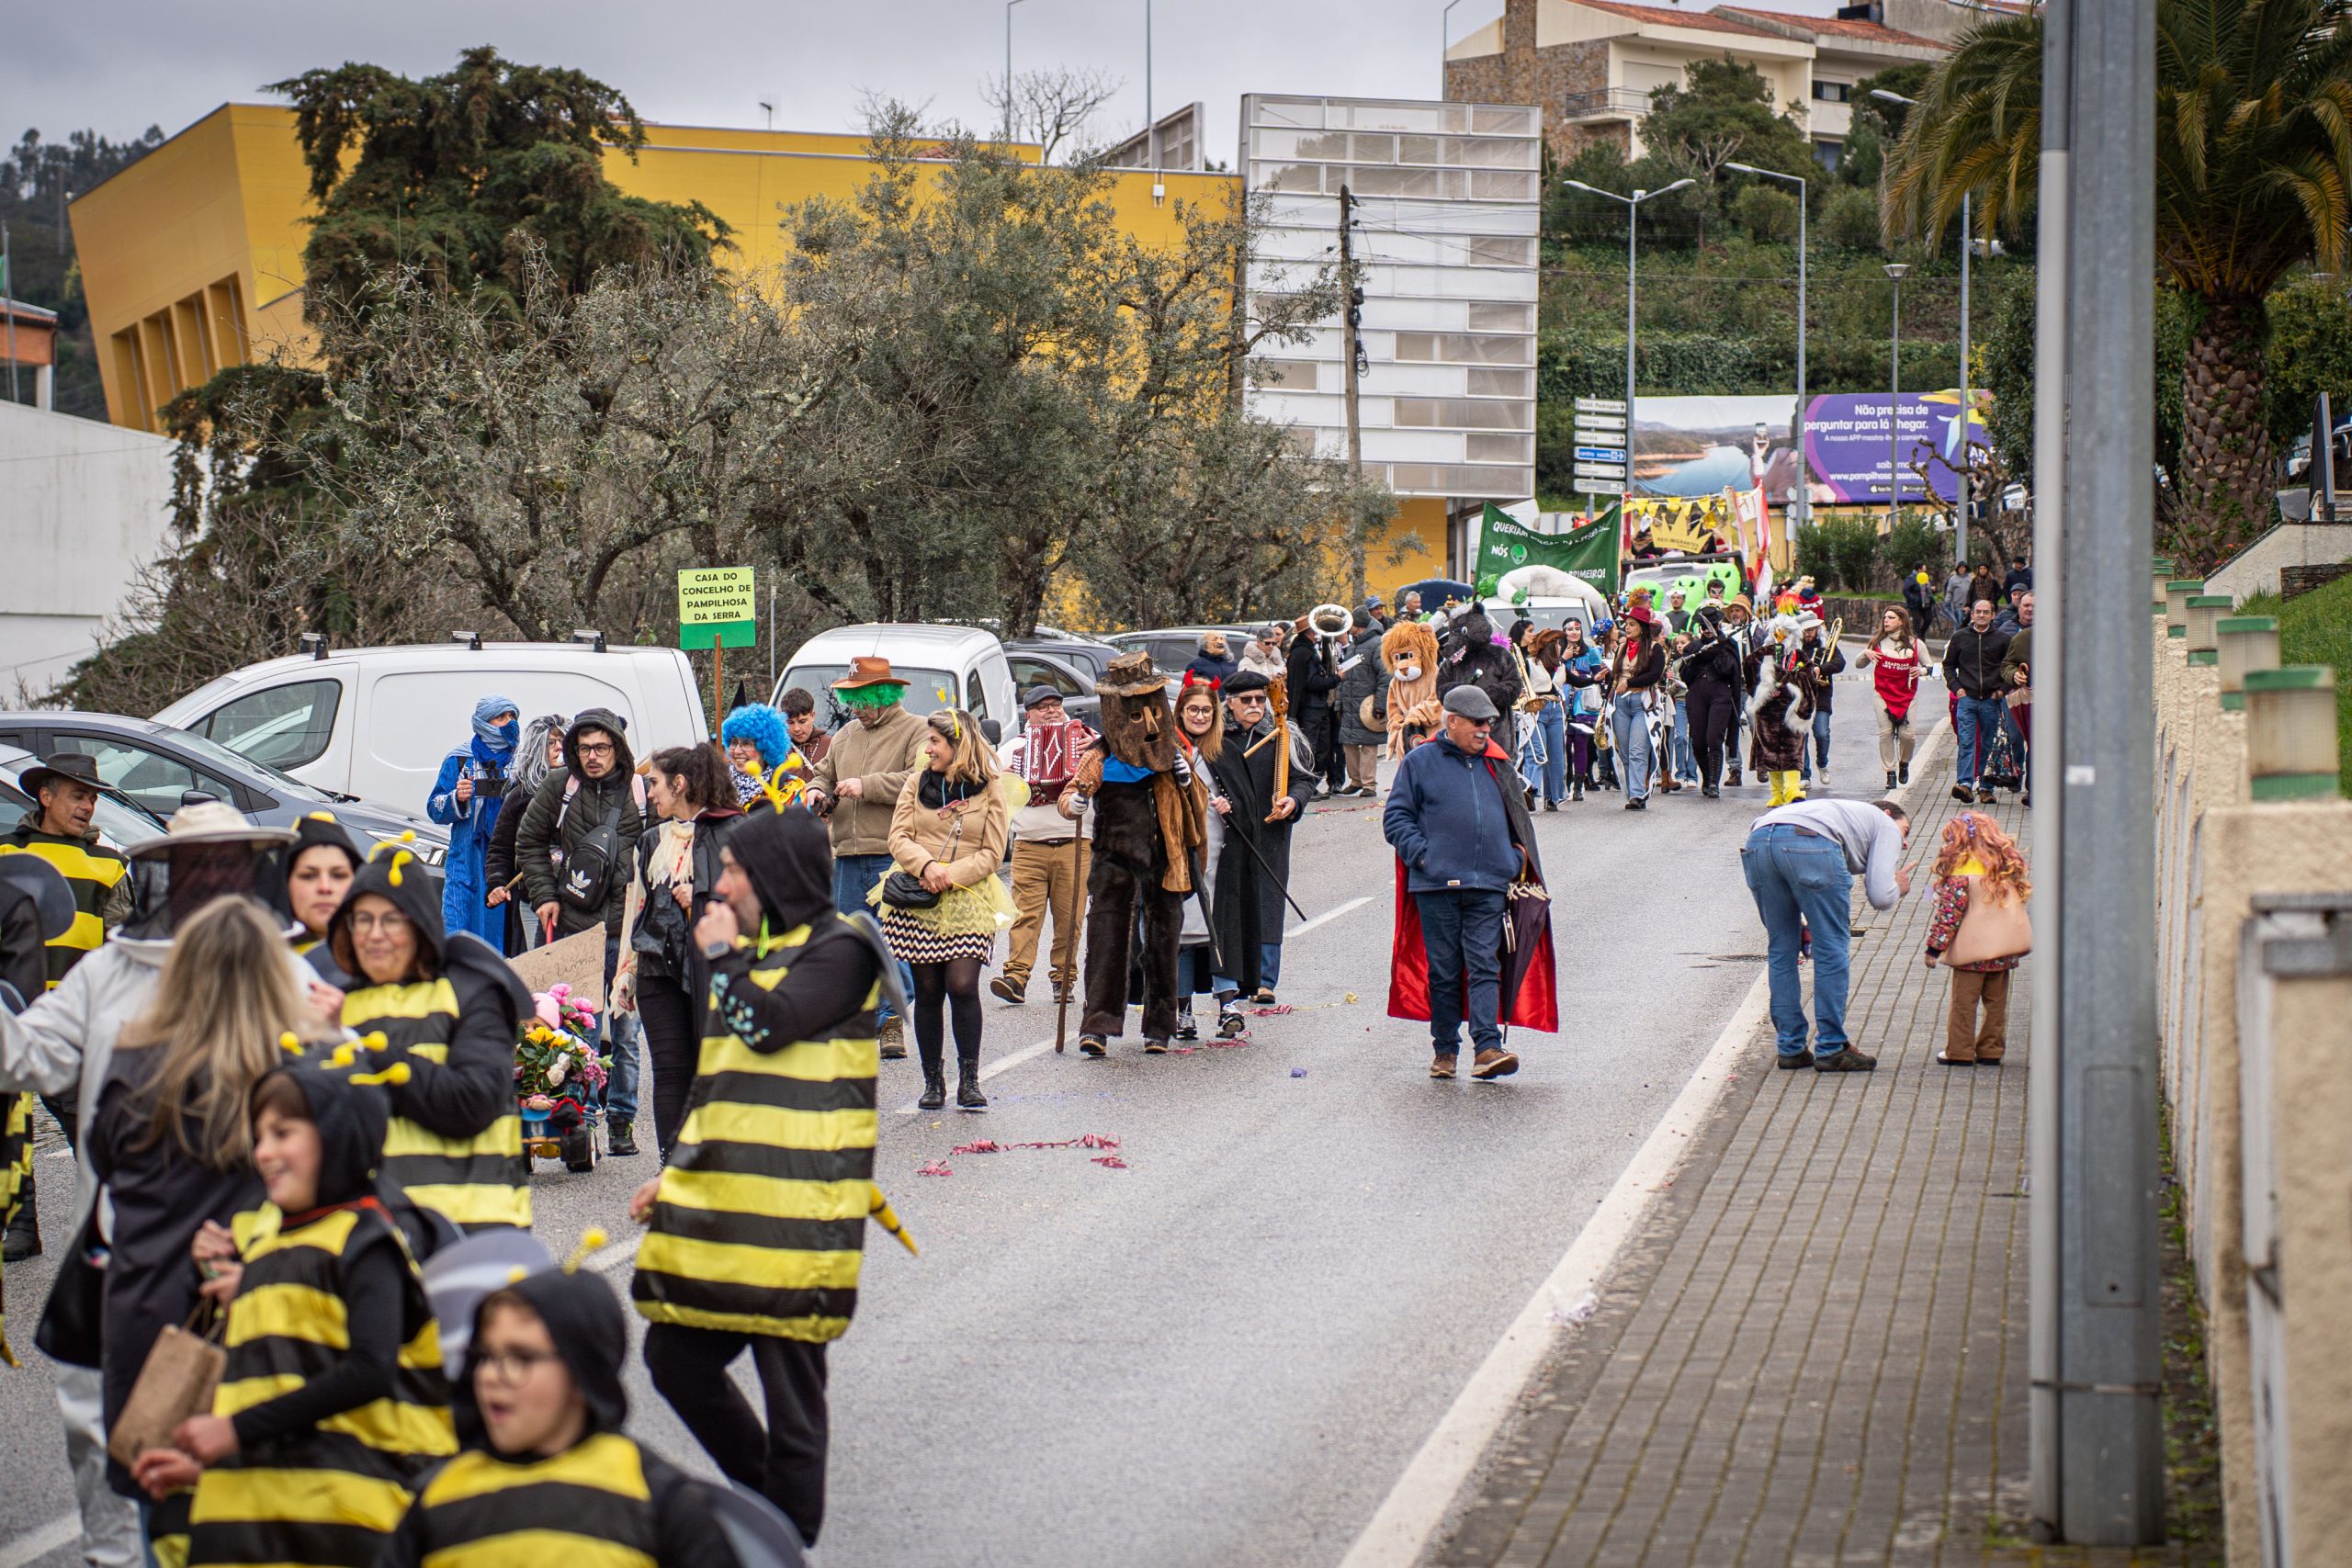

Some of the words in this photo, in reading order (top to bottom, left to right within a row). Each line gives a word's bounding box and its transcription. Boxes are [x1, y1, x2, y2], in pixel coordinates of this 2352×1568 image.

[1855, 404, 1875, 416] Não
[1916, 404, 1928, 415] de
[1804, 420, 1853, 433] perguntar
[1855, 422, 1878, 433] para
[1880, 419, 1889, 430] lá
[1891, 419, 1928, 432] hegar.
[1876, 460, 1893, 468] saib
[1493, 521, 1529, 537] QUERIAM
[1491, 544, 1509, 558] NÓS
[695, 573, 718, 582] CASA
[723, 572, 738, 581] DO
[683, 585, 734, 595] CONCELHO
[739, 584, 752, 592] DE
[687, 598, 747, 608] PAMPILHOSA
[694, 613, 708, 621] DA
[713, 611, 741, 619] SERRA
[566, 883, 585, 899] adidas
